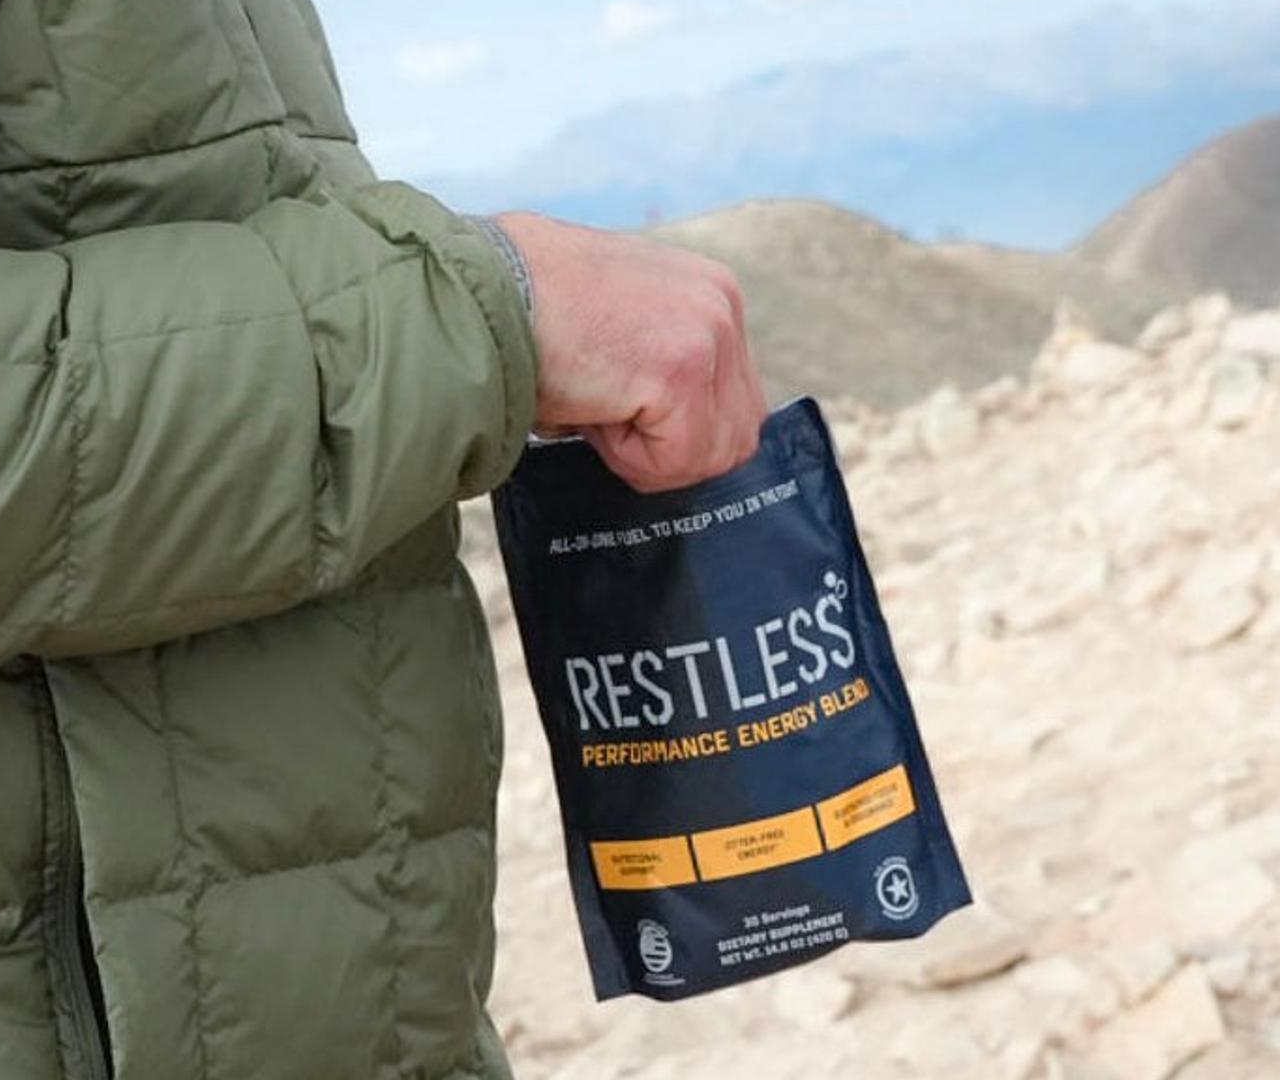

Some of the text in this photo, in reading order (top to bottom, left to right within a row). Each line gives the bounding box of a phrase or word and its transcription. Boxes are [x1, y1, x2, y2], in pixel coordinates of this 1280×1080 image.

[649, 521, 672, 538] TO
[673, 512, 713, 535] KEEP
[713, 501, 745, 523] YOU
[566, 593, 855, 730] RESTLESS
[581, 677, 870, 767] PERFORMANCE ENERGY BLEND
[717, 911, 844, 953] DIETARY SUPPLEMENT
[720, 951, 742, 966] NET
